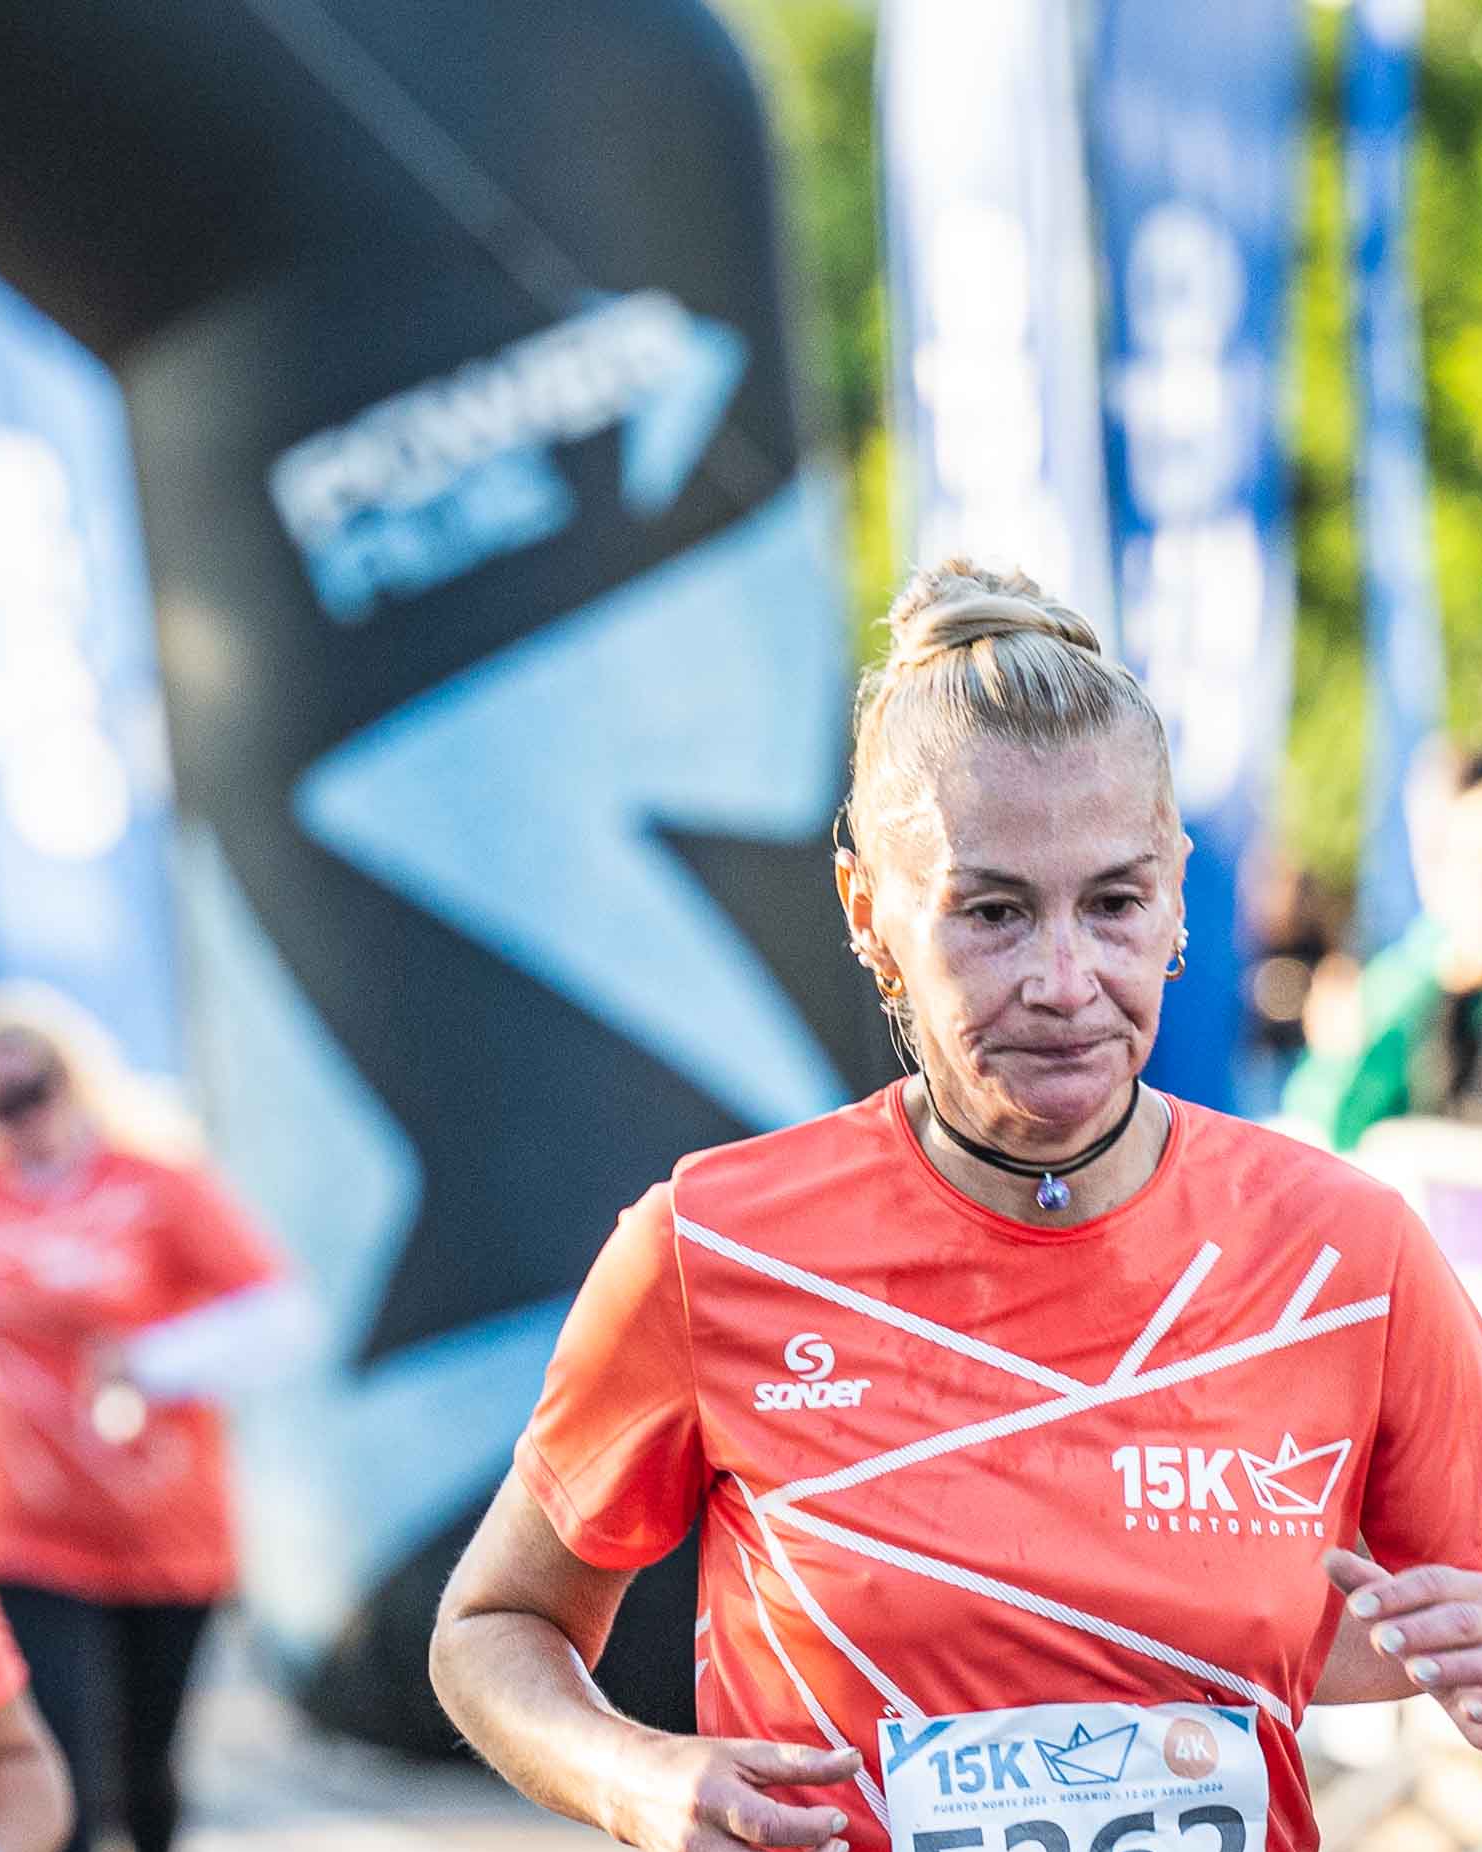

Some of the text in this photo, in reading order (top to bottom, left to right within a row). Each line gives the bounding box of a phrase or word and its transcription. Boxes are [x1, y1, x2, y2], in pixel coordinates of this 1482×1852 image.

[1111, 1445, 1239, 1511] 15K
[1125, 1514, 1325, 1538] PUERTO NORTE
[1174, 1735, 1212, 1762] 4K
[928, 1742, 1031, 1796] 15K
